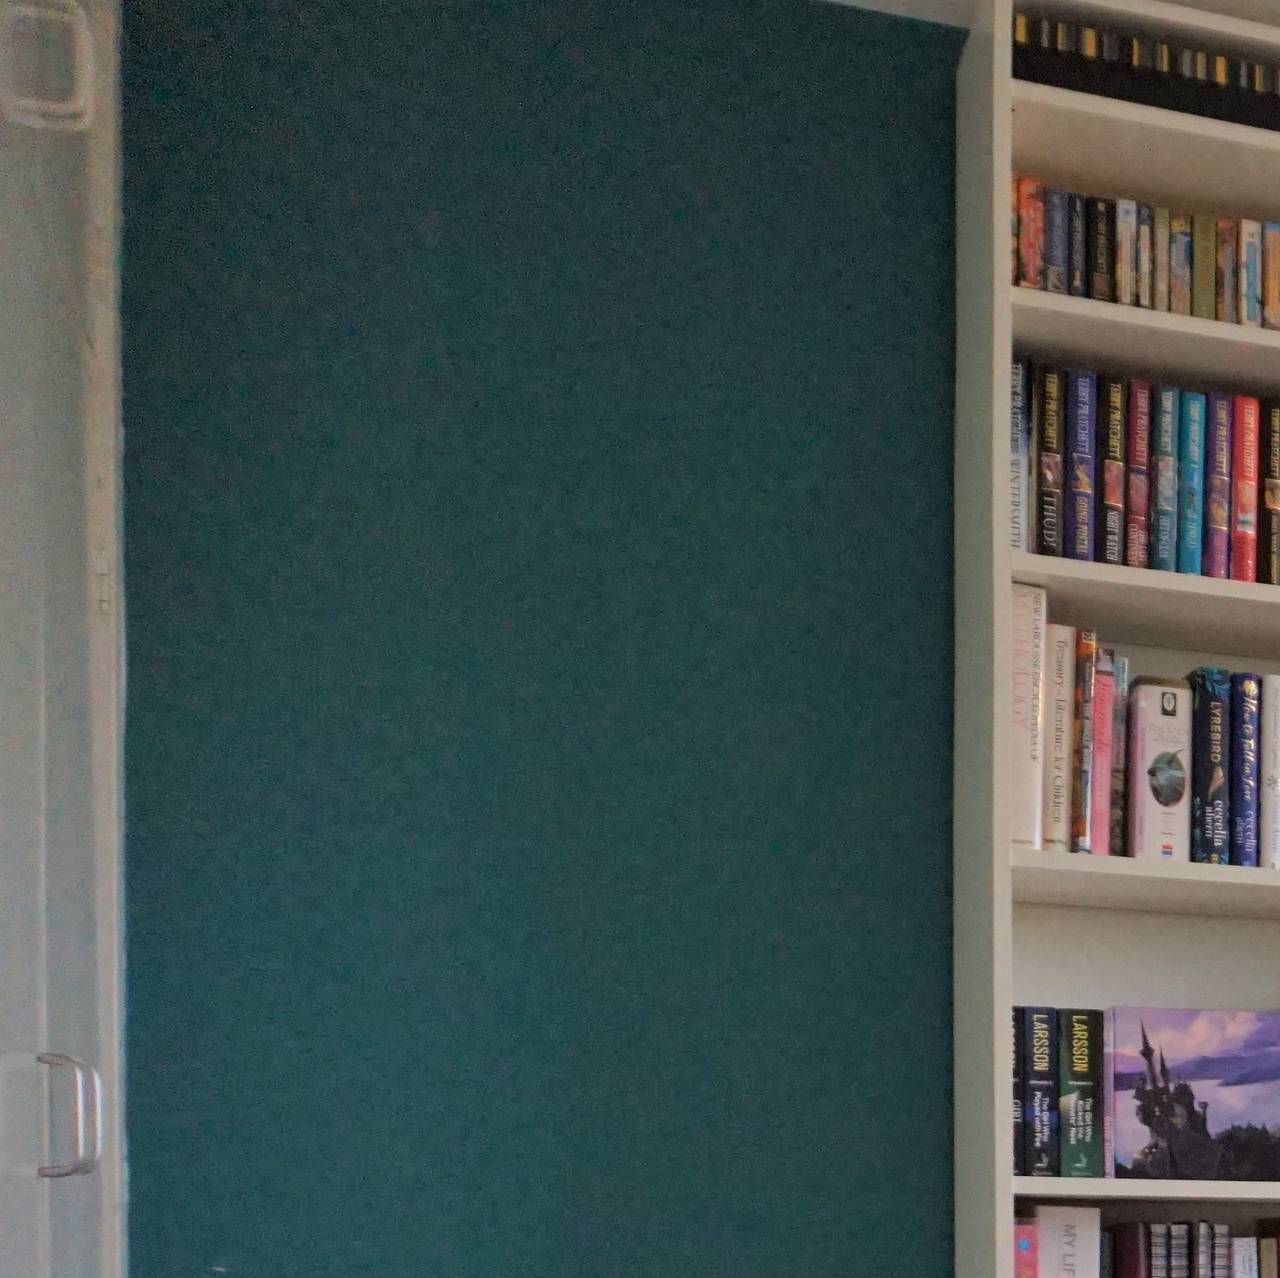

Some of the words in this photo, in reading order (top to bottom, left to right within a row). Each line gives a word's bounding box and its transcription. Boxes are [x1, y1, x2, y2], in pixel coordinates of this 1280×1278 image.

[1108, 383, 1121, 408] TERRY
[1108, 409, 1121, 459] PRATCHETT
[1107, 510, 1120, 533] NIGHT
[1106, 535, 1120, 561] WATCH
[1209, 701, 1223, 764] LYREBIRD
[1204, 806, 1215, 839] ahern
[1213, 800, 1227, 846] cecelia
[1033, 1014, 1049, 1071] LARSSON
[1072, 1015, 1089, 1072] LARSSON
[1064, 1224, 1077, 1248] MY
